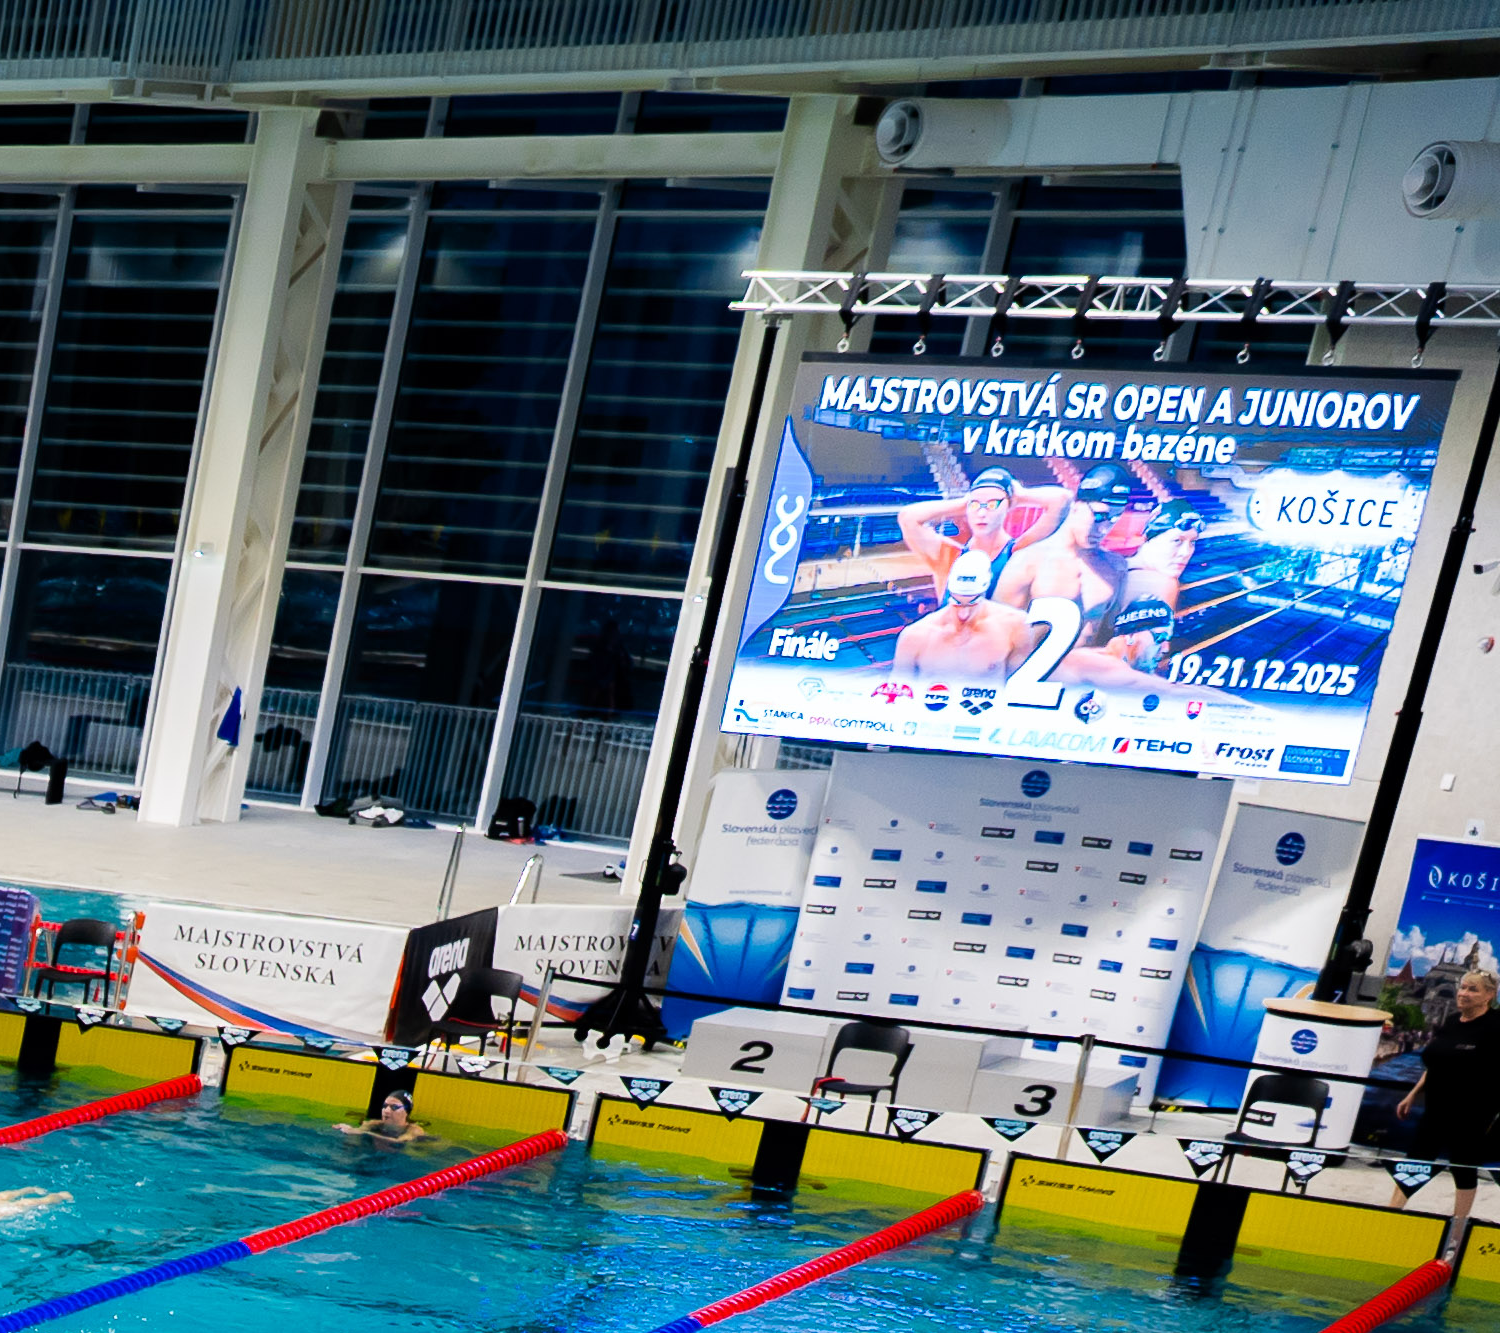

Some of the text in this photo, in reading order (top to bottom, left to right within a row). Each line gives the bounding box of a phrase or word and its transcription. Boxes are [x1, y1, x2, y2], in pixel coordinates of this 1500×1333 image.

[820, 373, 1420, 431] MAJSTROVSTVÁ SR OPEN A JUNIOROV
[963, 421, 1235, 463] v krátkom bazéne
[1276, 490, 1398, 529] KOŠICE
[769, 628, 840, 663] Finále
[1008, 598, 1082, 710] 2
[1168, 654, 1359, 696] 19.-21.12.2025
[1134, 739, 1192, 755] TEHO
[1216, 743, 1275, 762] Frost
[173, 923, 366, 965] MAJSTROVSTVÁ
[427, 937, 470, 978] arena
[194, 951, 338, 987] SLOVENSKA
[730, 1041, 775, 1074] 2
[1013, 1084, 1057, 1116] 3
